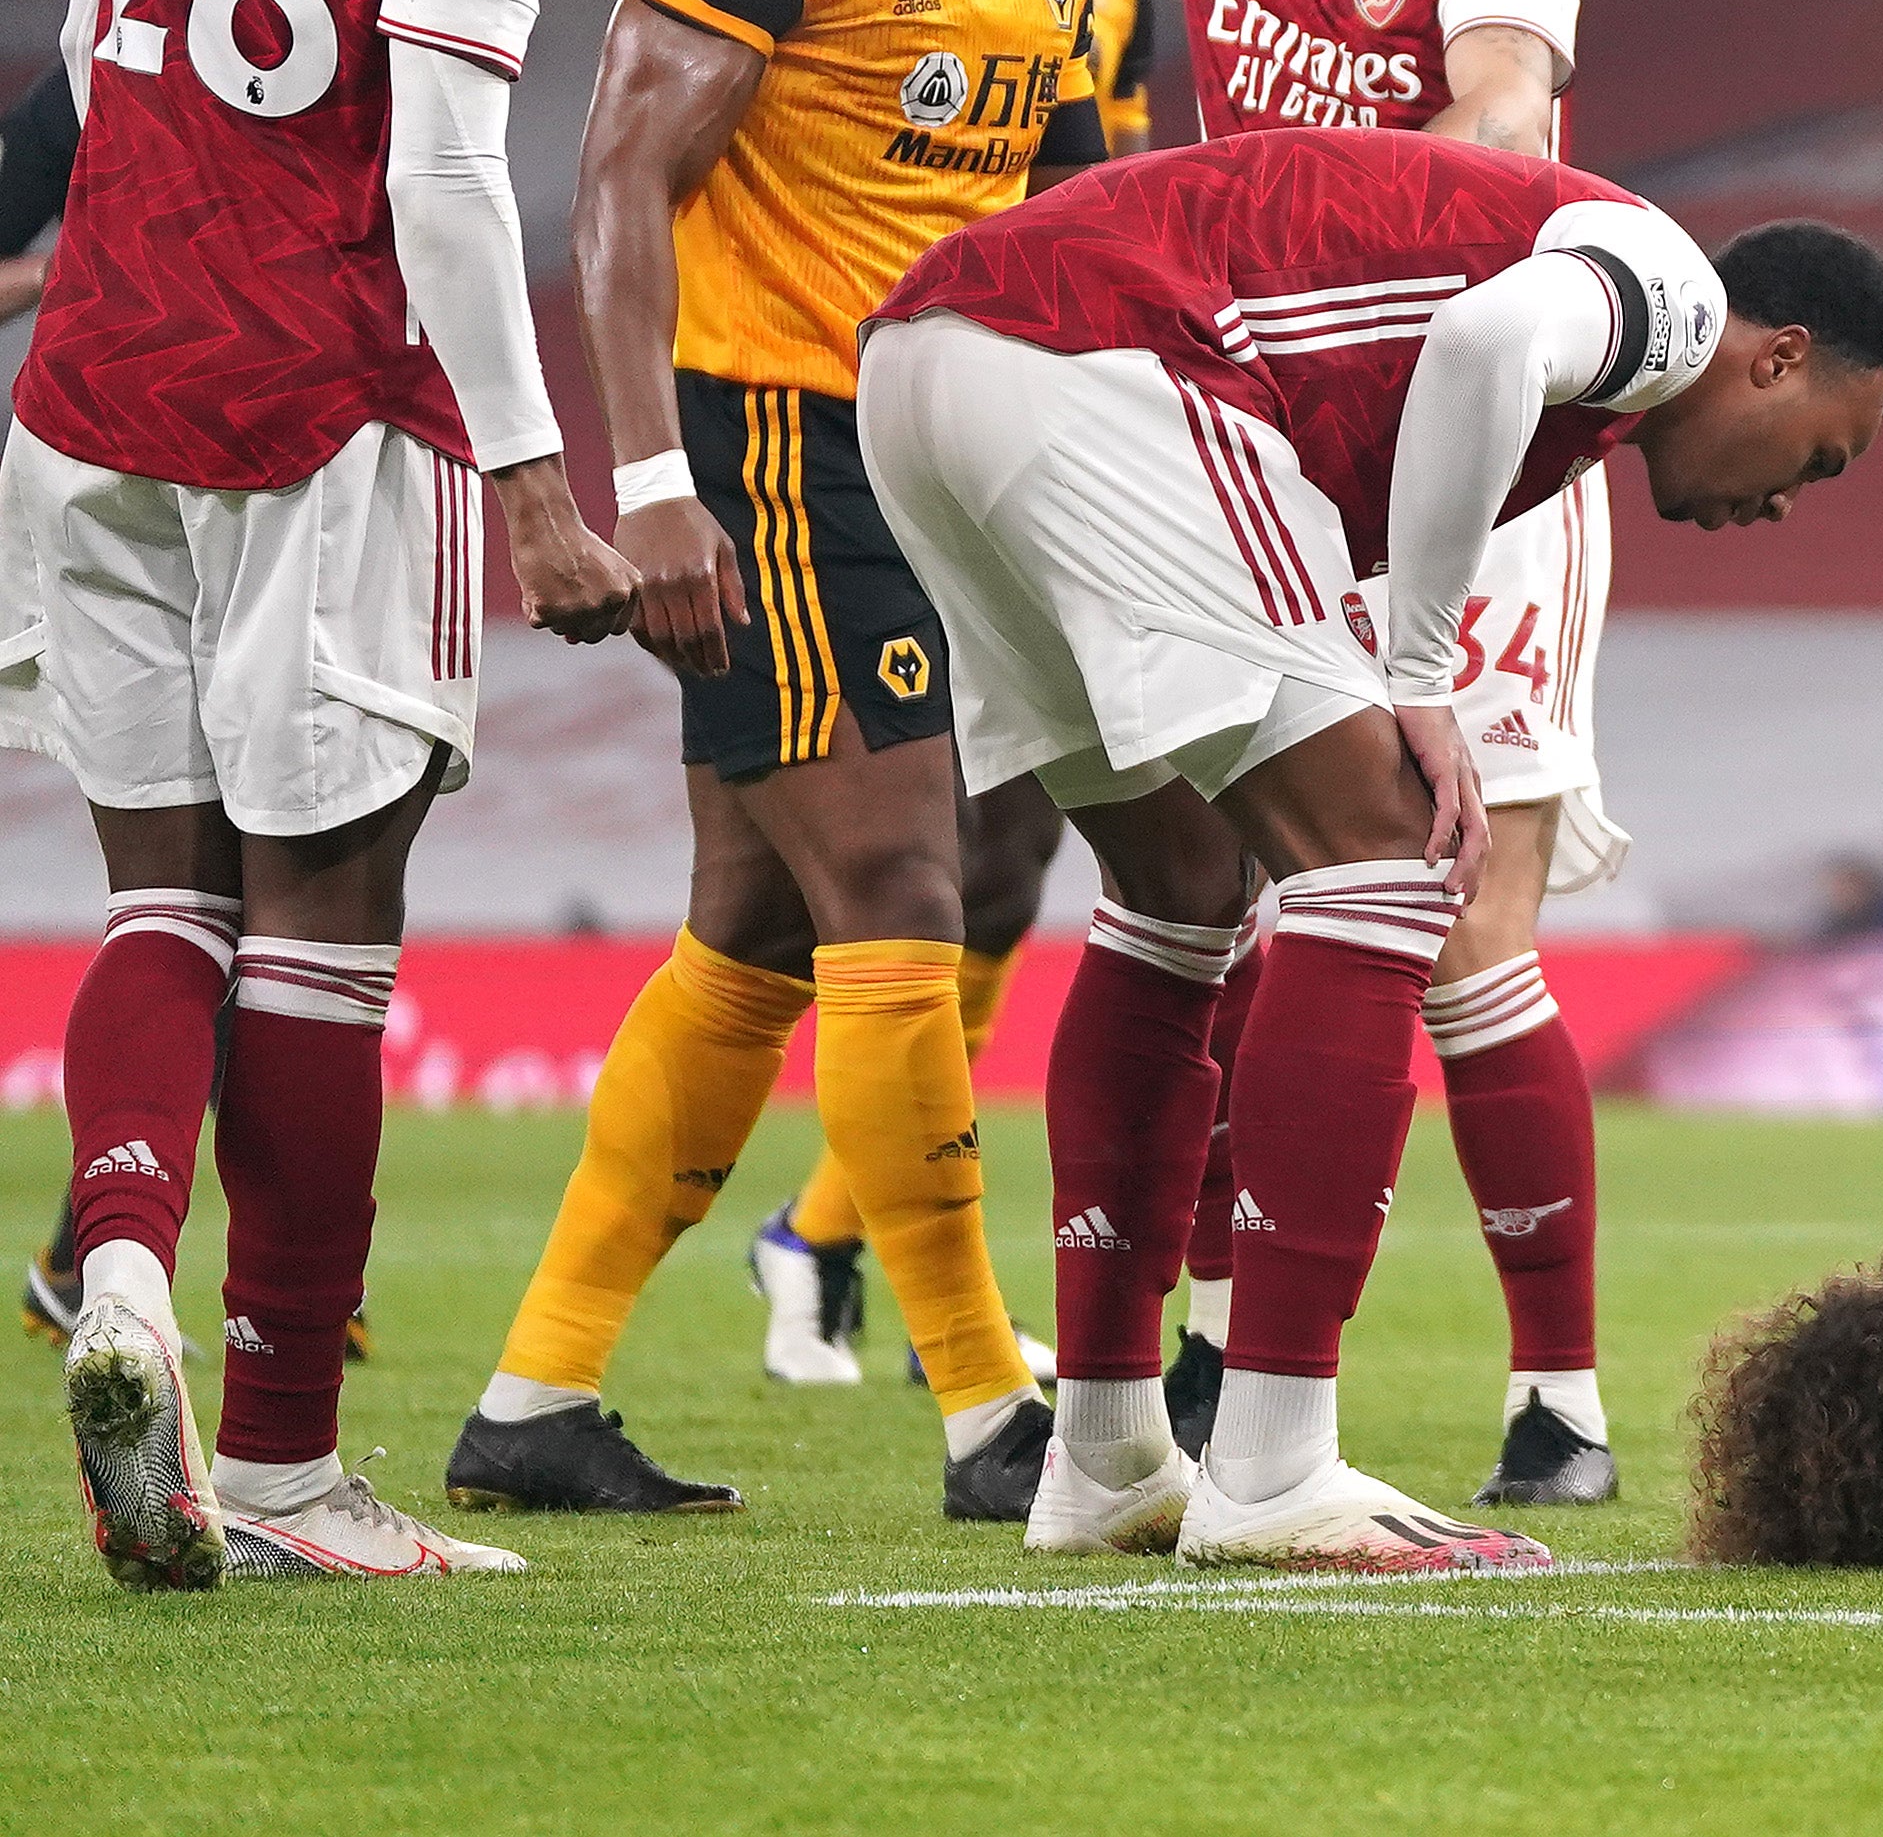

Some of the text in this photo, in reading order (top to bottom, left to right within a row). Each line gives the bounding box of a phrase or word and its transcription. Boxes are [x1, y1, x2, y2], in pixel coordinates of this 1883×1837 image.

[966, 53, 1064, 130] 万博
[1226, 53, 1283, 113] FLY
[881, 127, 1042, 175] ManBet
[1451, 595, 1551, 705] 34
[1481, 731, 1540, 752] adidas
[84, 1158, 171, 1182] adidas
[1054, 1233, 1133, 1252] adidas
